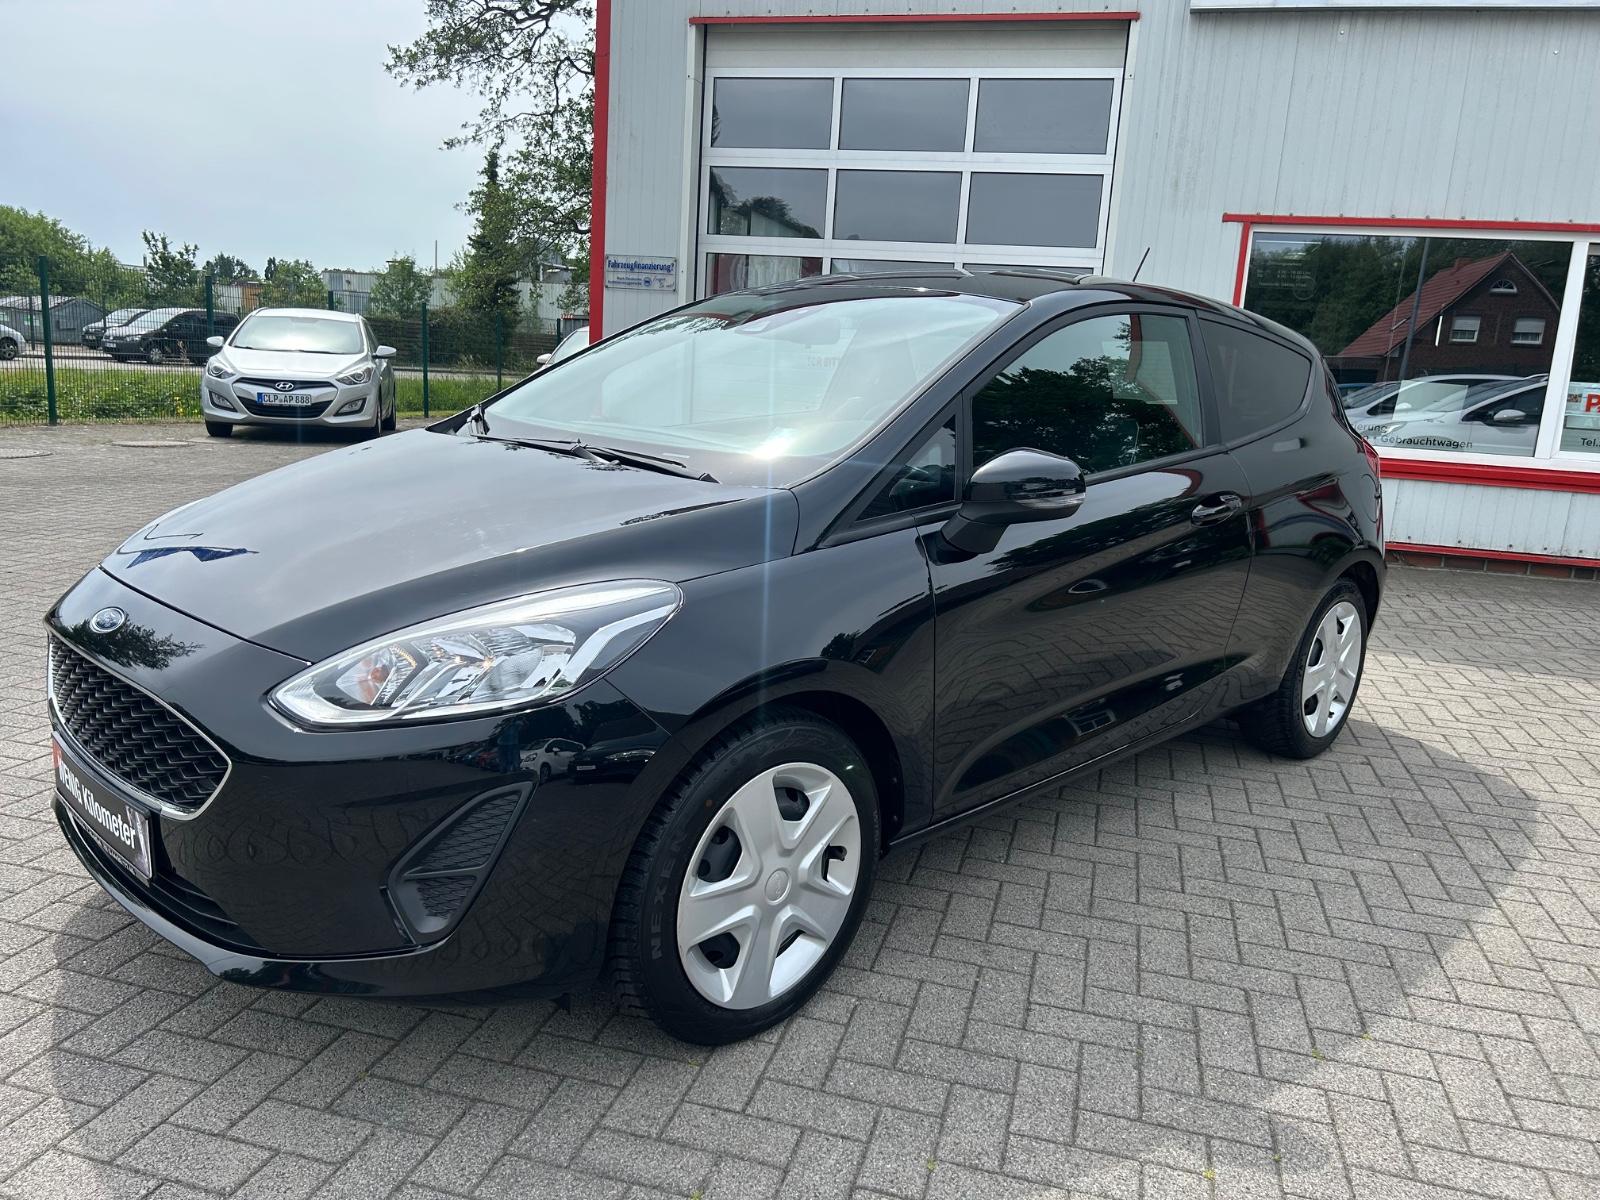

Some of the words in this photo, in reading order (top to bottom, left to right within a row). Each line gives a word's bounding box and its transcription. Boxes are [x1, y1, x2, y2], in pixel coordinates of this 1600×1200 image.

[607, 259, 675, 273] Fahrzeugfinanzierung?
[263, 394, 279, 403] CLP
[283, 395, 294, 404] AP
[295, 395, 310, 405] 888
[1380, 434, 1473, 449] Gebrauchtwagen
[81, 784, 136, 849] Kilometer
[649, 835, 687, 960] NEXEN
